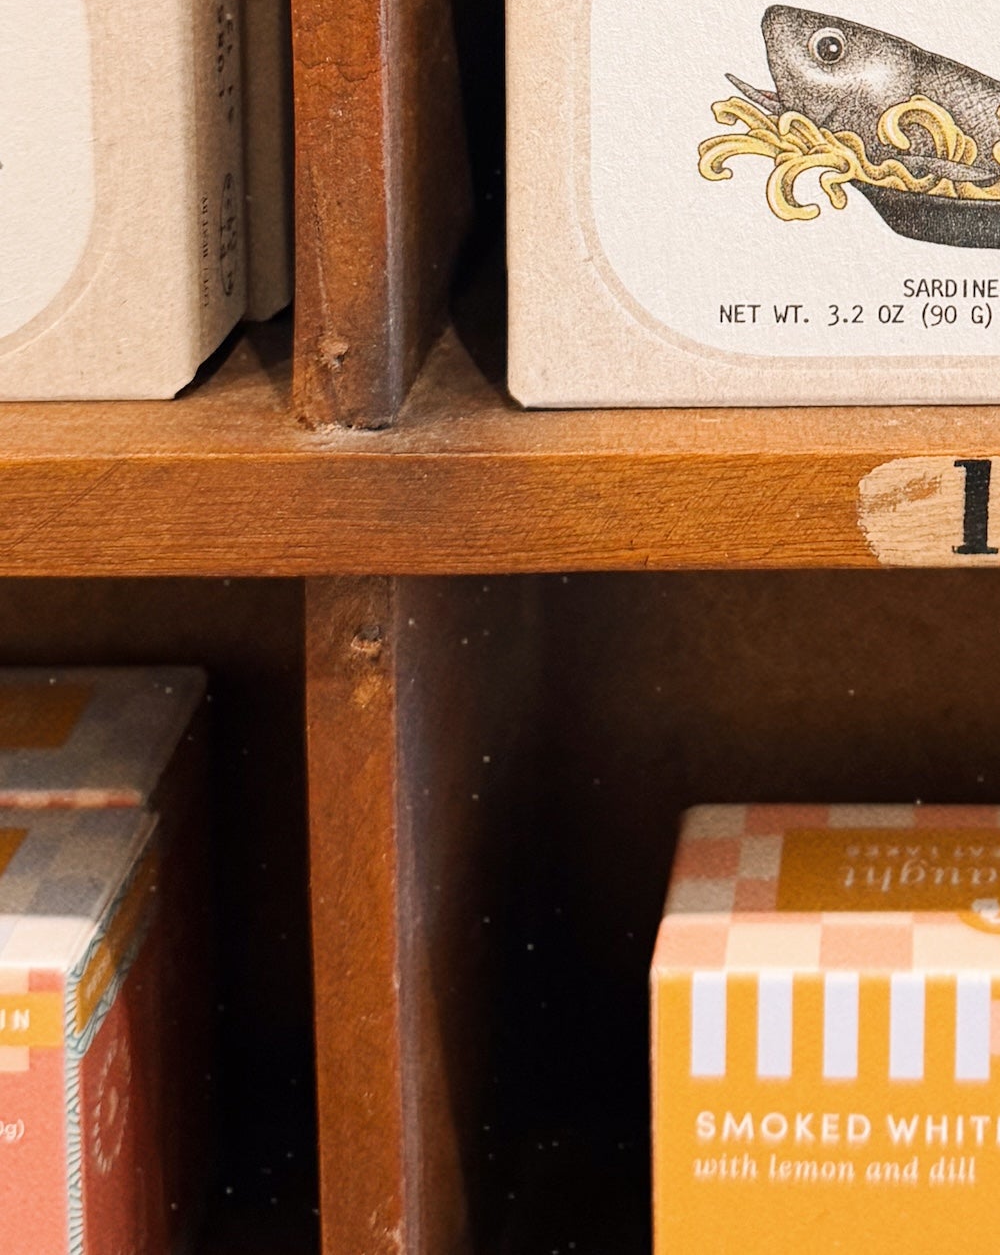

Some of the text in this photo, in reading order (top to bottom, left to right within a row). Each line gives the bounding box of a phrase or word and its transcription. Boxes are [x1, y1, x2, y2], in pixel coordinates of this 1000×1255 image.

[719, 304, 761, 324] NET
[773, 304, 810, 324] WT.
[827, 304, 865, 327] 3.2
[877, 305, 905, 324] OZ
[921, 302, 958, 329] (90
[971, 302, 993, 329] G)
[695, 1111, 872, 1144] SMOKED
[692, 1152, 977, 1187] with lemon and dill
